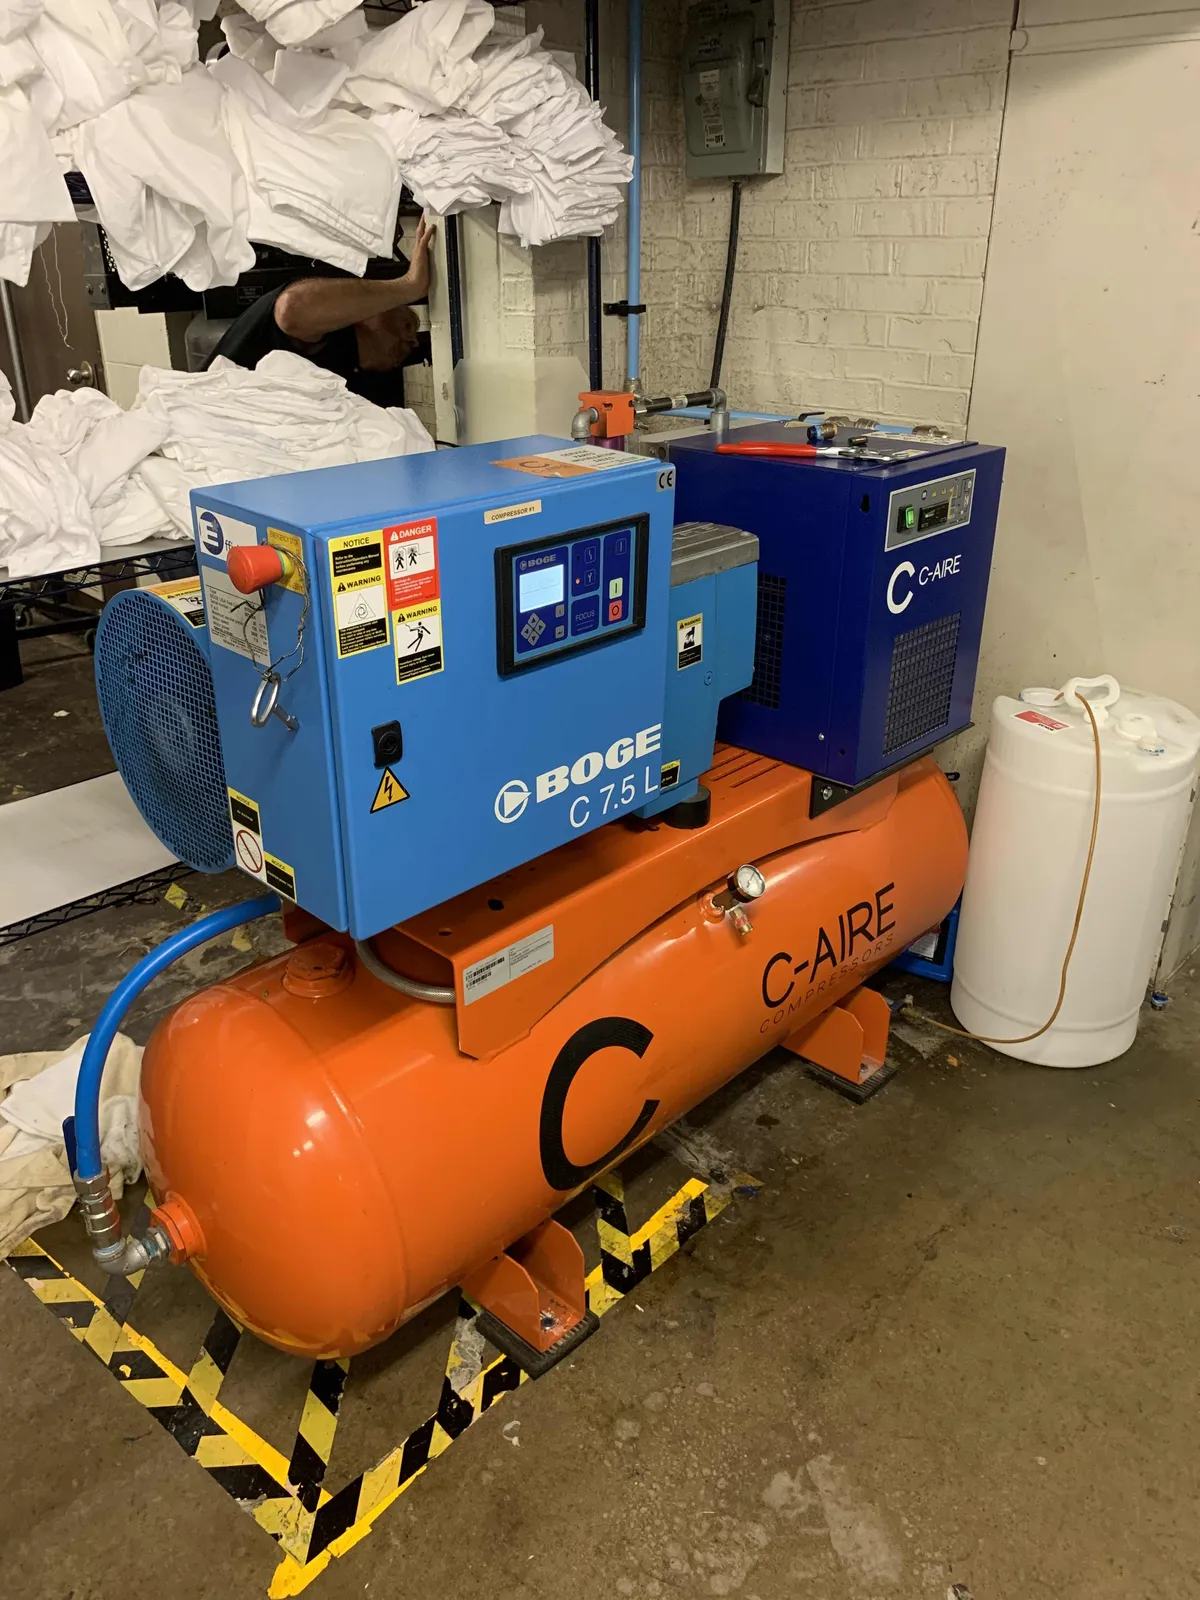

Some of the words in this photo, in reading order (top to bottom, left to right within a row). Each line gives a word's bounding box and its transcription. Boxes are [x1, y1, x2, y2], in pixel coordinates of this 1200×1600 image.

[658, 470, 673, 489] CE
[491, 507, 528, 521] COMPRESSOR
[399, 524, 432, 539] DANGER
[343, 536, 370, 548] NOTICE
[527, 554, 556, 567] BOGE
[918, 554, 962, 586] C-AIRE
[346, 575, 381, 589] WARNING
[886, 560, 916, 615] C
[405, 605, 438, 619] WARNING
[575, 609, 596, 621] FOCUS
[536, 722, 662, 804] BOGE
[569, 795, 590, 828] C
[599, 774, 635, 815] 7.5
[644, 766, 659, 794] L
[761, 881, 896, 1009] C-AIRE
[759, 933, 894, 1034] COMPRESSORS
[539, 1016, 660, 1191] C
